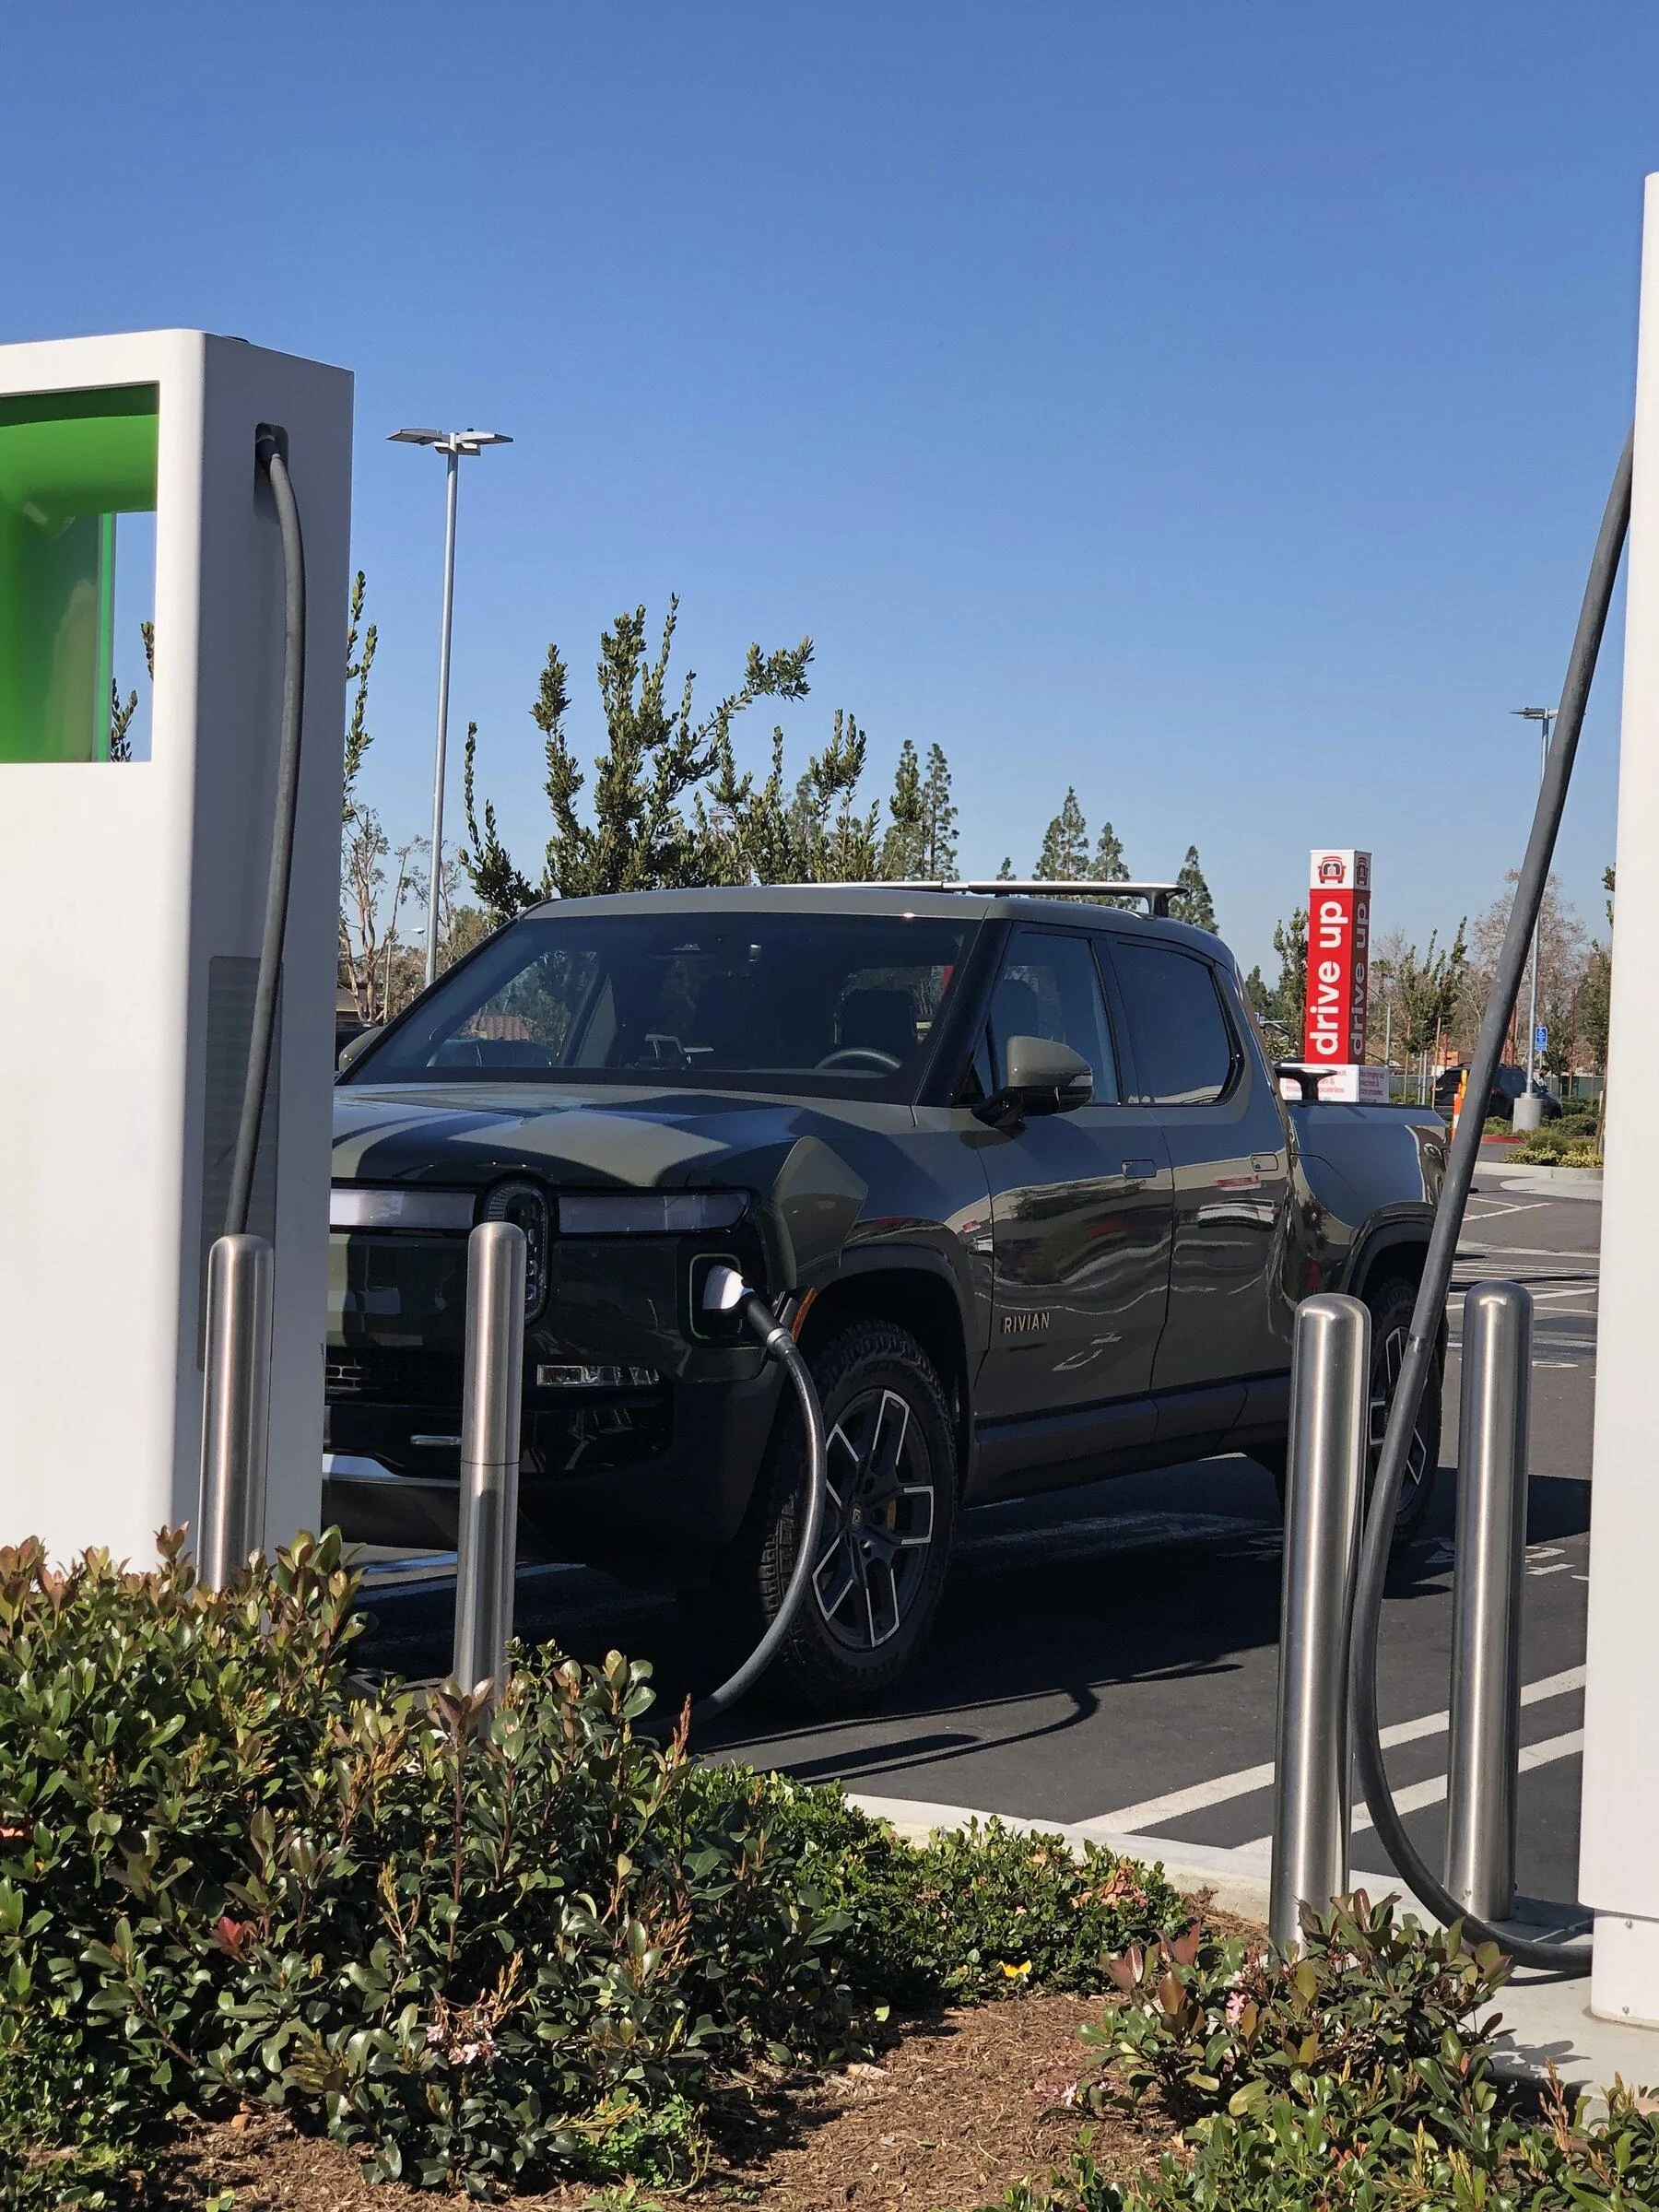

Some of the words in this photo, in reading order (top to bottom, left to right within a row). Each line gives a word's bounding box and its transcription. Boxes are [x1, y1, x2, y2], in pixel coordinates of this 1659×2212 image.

[1319, 900, 1348, 949] up
[1356, 902, 1369, 949] up
[1310, 960, 1341, 1055] drive
[1351, 961, 1365, 1055] drive
[1004, 1312, 1050, 1334] RIVIAN
